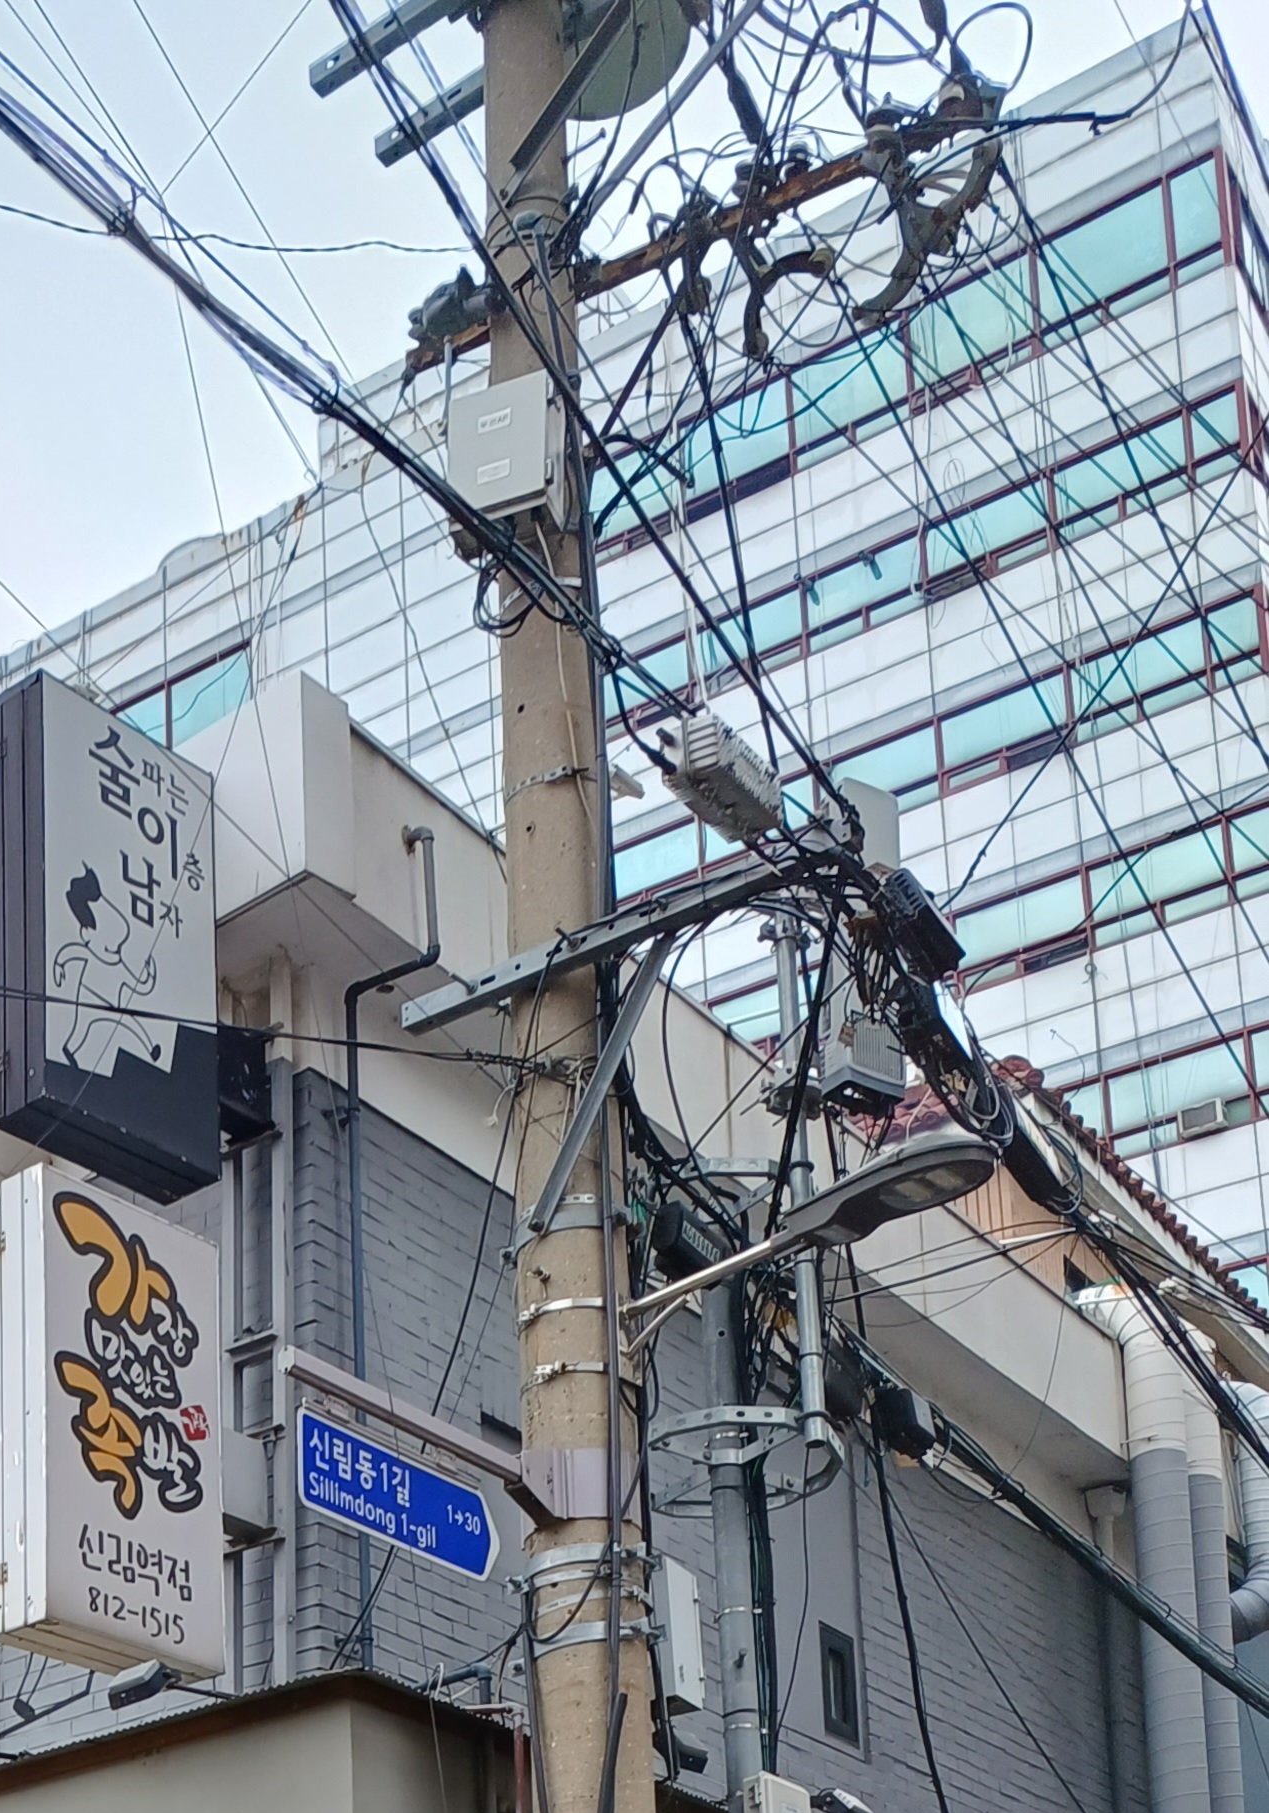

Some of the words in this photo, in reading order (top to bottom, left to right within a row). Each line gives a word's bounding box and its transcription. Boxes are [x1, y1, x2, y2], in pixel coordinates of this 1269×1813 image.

[57, 1356, 201, 1514] 족발
[309, 1427, 411, 1508] 신림동1길
[309, 1471, 396, 1535] Sillimdong
[400, 1512, 437, 1549] 1-gil
[78, 1523, 192, 1602] 신림역점
[88, 1586, 186, 1645] 812-1515
